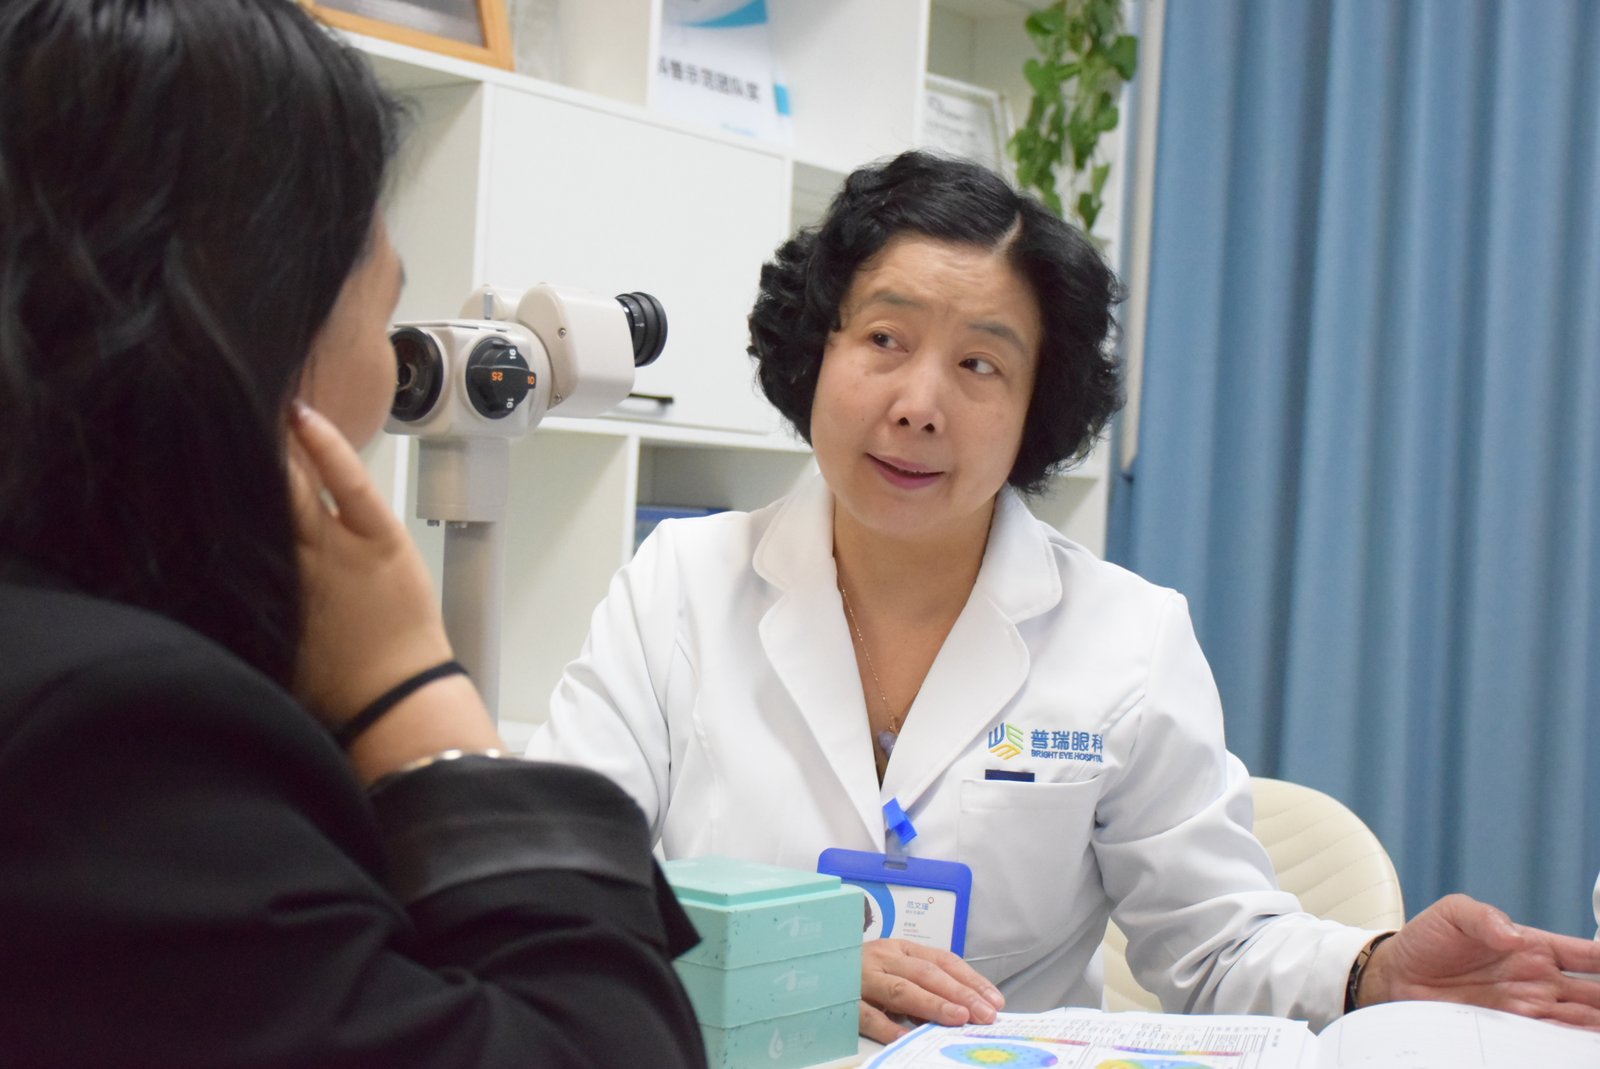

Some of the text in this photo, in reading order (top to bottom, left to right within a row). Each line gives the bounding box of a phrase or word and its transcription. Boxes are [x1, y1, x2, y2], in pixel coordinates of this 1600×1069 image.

[1031, 729, 1103, 753] 普瑞眼科
[1031, 749, 1058, 759] BRIGHT
[1059, 751, 1073, 760] EYE
